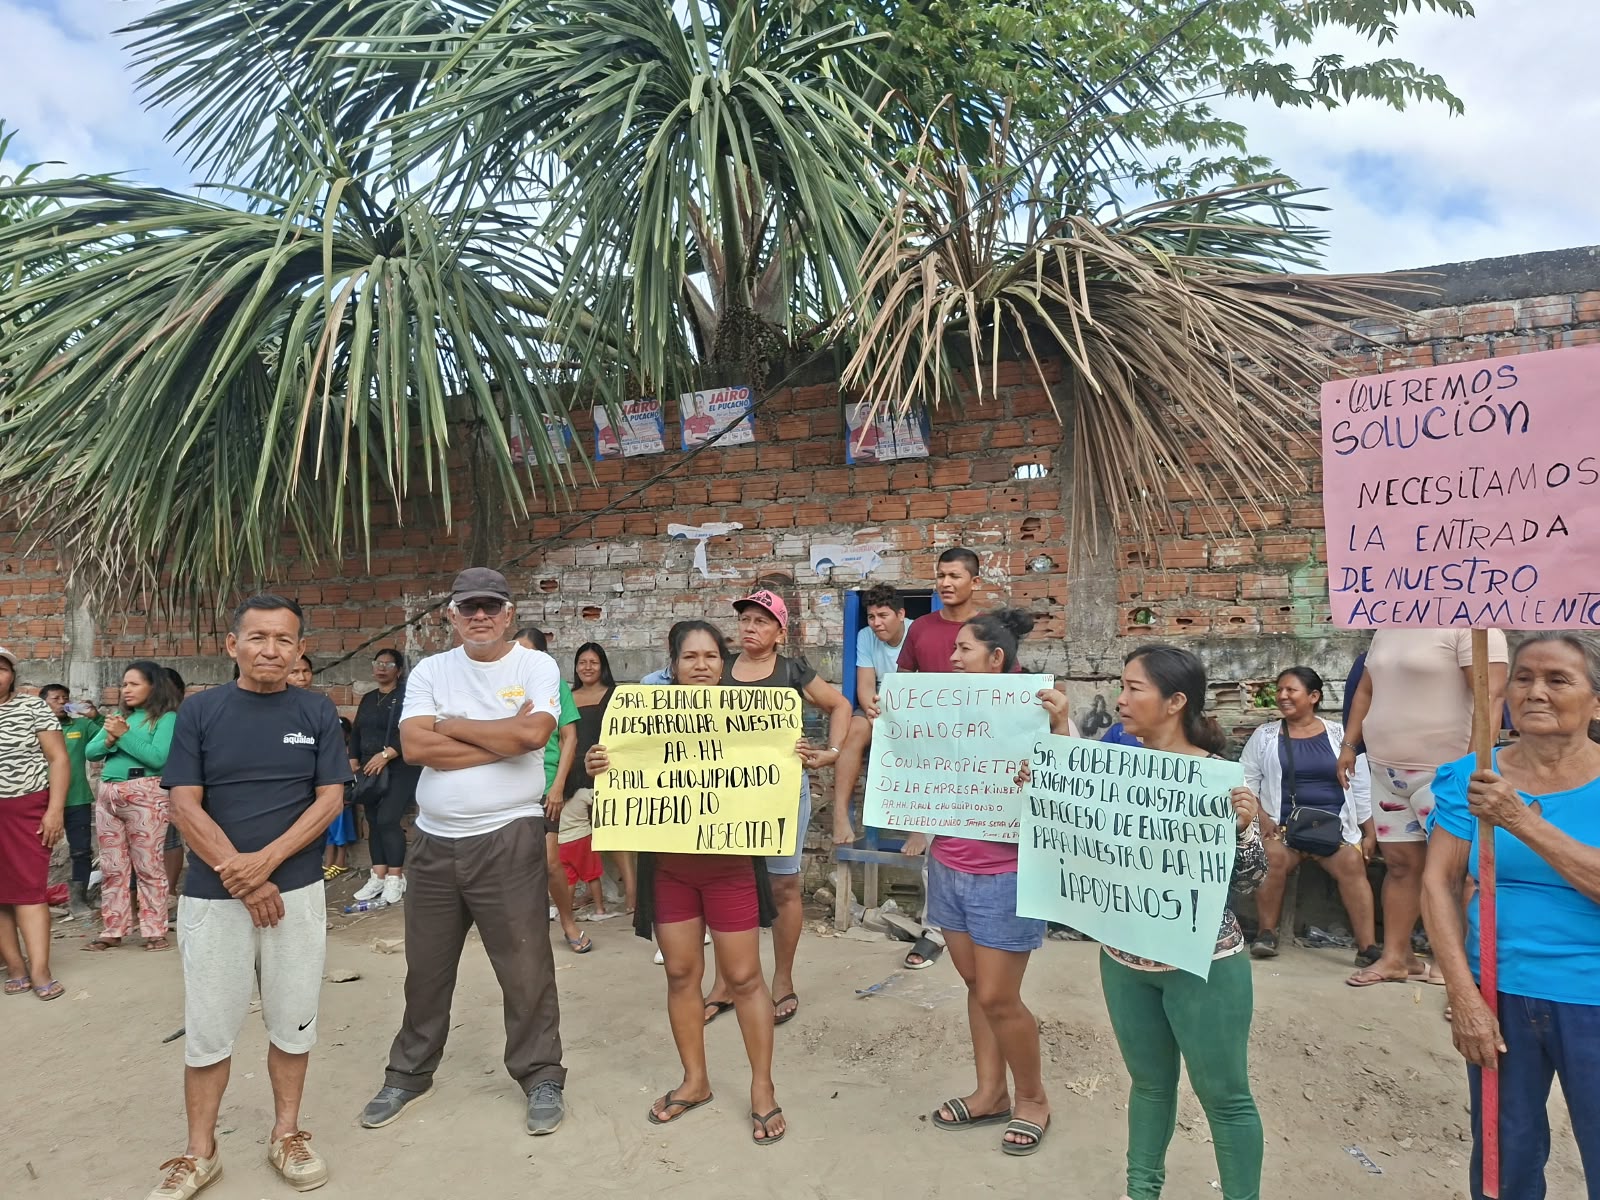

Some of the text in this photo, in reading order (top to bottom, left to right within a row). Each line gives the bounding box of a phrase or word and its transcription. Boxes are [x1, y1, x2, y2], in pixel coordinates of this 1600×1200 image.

[1348, 364, 1518, 414] QUEREMOS
[630, 411, 659, 421] PUCACHO
[717, 400, 749, 411] PUCACHO
[1349, 514, 1569, 551] LA ENTRADA
[1331, 556, 1538, 595] DE NUESTRO
[612, 689, 797, 712] SRA. BLANCA APOYANOS
[609, 714, 799, 736] A DESARROLLAR NUESTRO
[283, 735, 315, 745] aqualab
[881, 751, 913, 768] CON
[1068, 746, 1208, 788] GOBERNADOR
[607, 764, 780, 790] RAUL CHUQUIPIONDO
[875, 775, 900, 791] DE
[904, 780, 920, 793] LA
[924, 782, 979, 795] EMPRESA
[1031, 769, 1095, 799] EXIGIMOS
[1101, 779, 1119, 803] LA
[625, 795, 692, 826] PUEBLO
[700, 792, 720, 816] LO
[910, 800, 931, 810] RAUL
[903, 814, 937, 827] PUEBLO
[1030, 796, 1228, 845] DE ACCESO DE ENTRADA
[1033, 824, 1072, 853] PARA
[1073, 833, 1154, 871] NUESTRO
